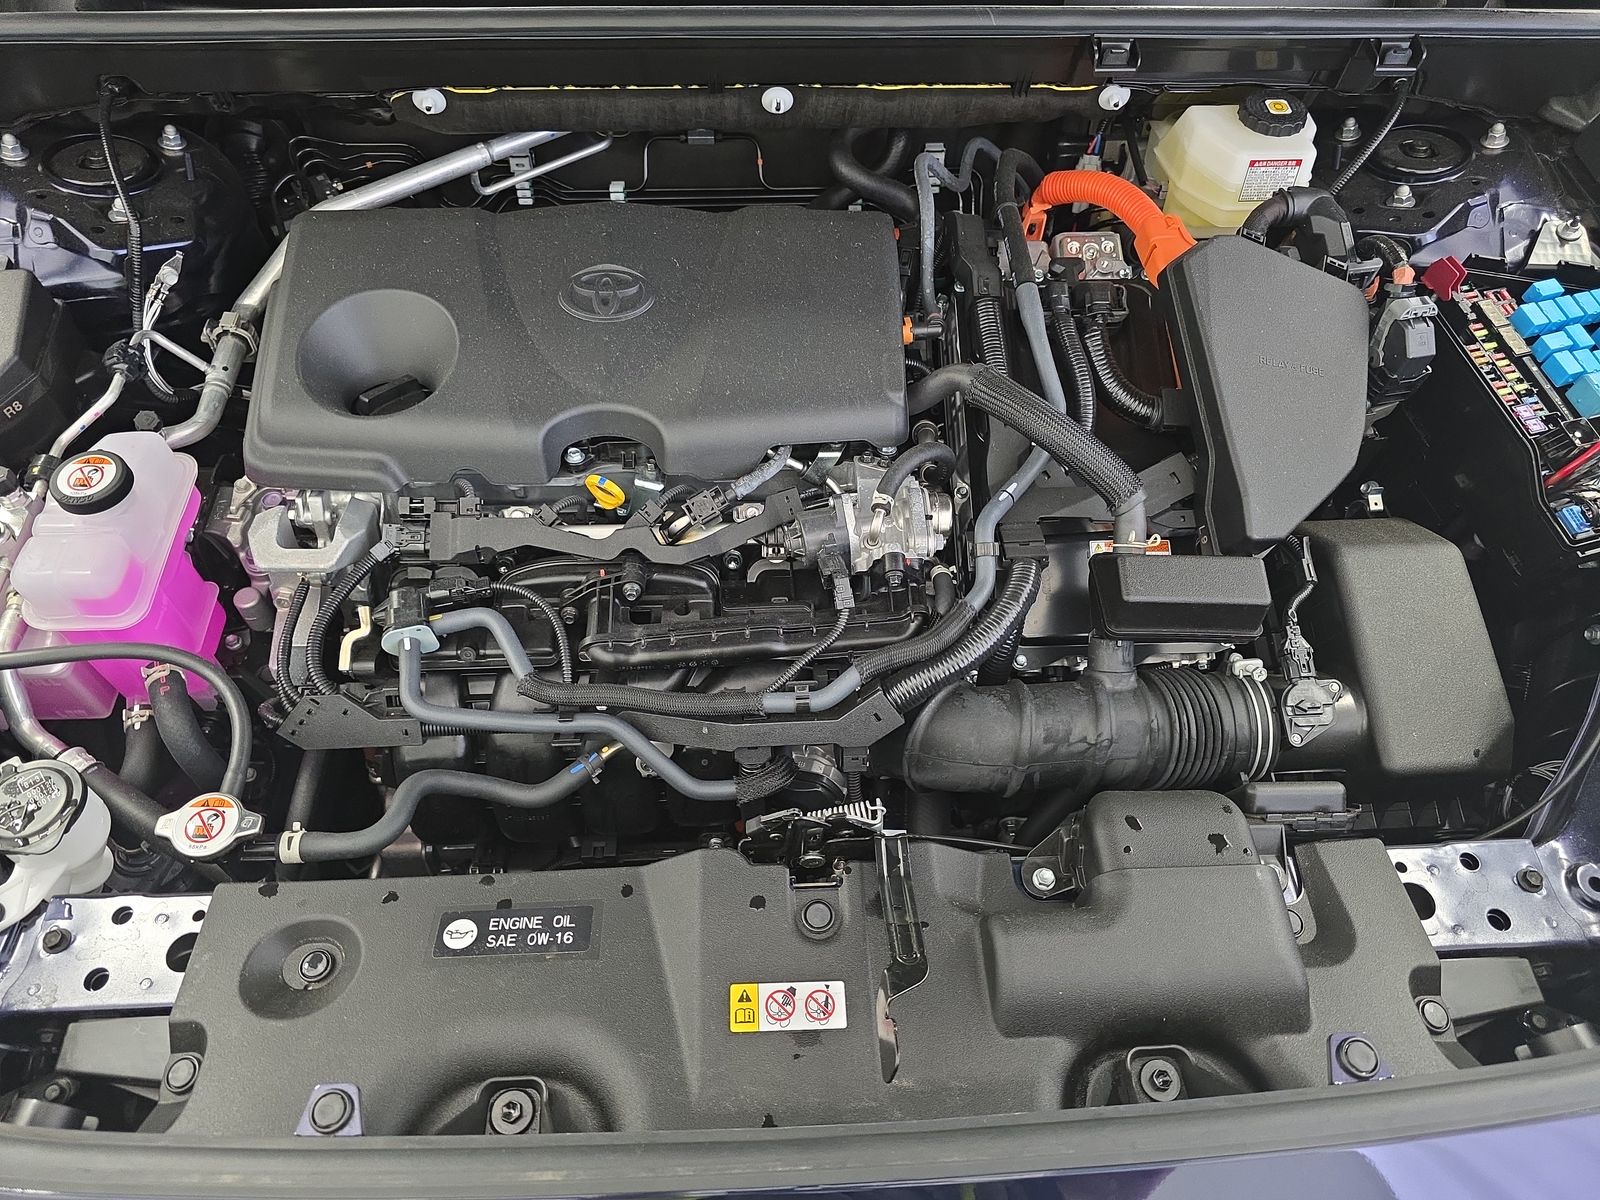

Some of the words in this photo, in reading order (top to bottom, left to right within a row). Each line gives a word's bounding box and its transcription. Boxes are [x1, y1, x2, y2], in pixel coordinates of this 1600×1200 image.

[1258, 355, 1289, 369] RELAY
[1299, 364, 1325, 377] FUSE
[3, 400, 23, 418] R8
[488, 916, 543, 931] ENGINE
[552, 914, 576, 928] OIL
[486, 933, 518, 948] SAE
[527, 931, 574, 946] 0W-16
